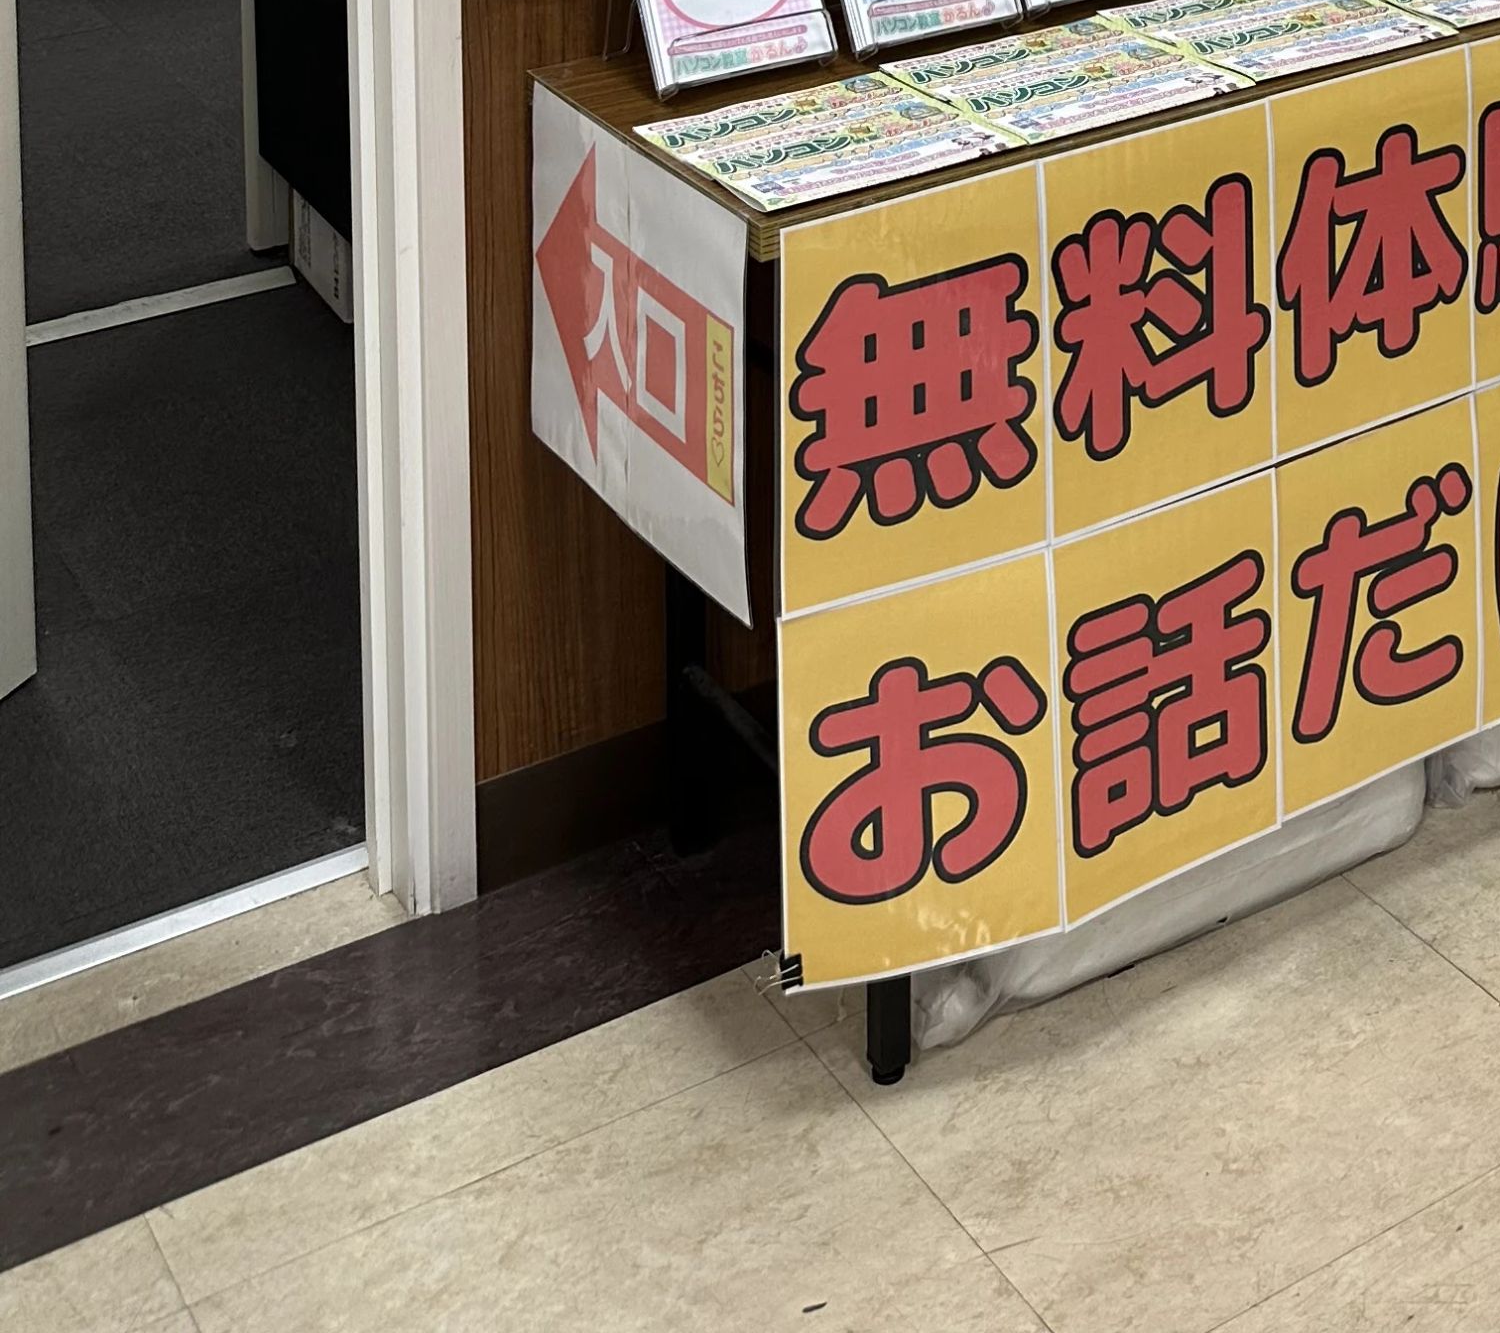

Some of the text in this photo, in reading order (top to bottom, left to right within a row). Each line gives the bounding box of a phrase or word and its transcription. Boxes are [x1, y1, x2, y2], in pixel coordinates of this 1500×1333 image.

[1191, 20, 1303, 55] パソコン
[965, 74, 1090, 113] パソコン
[662, 107, 799, 148] パソコン
[713, 135, 851, 176] パソコン
[583, 242, 688, 444] 入口
